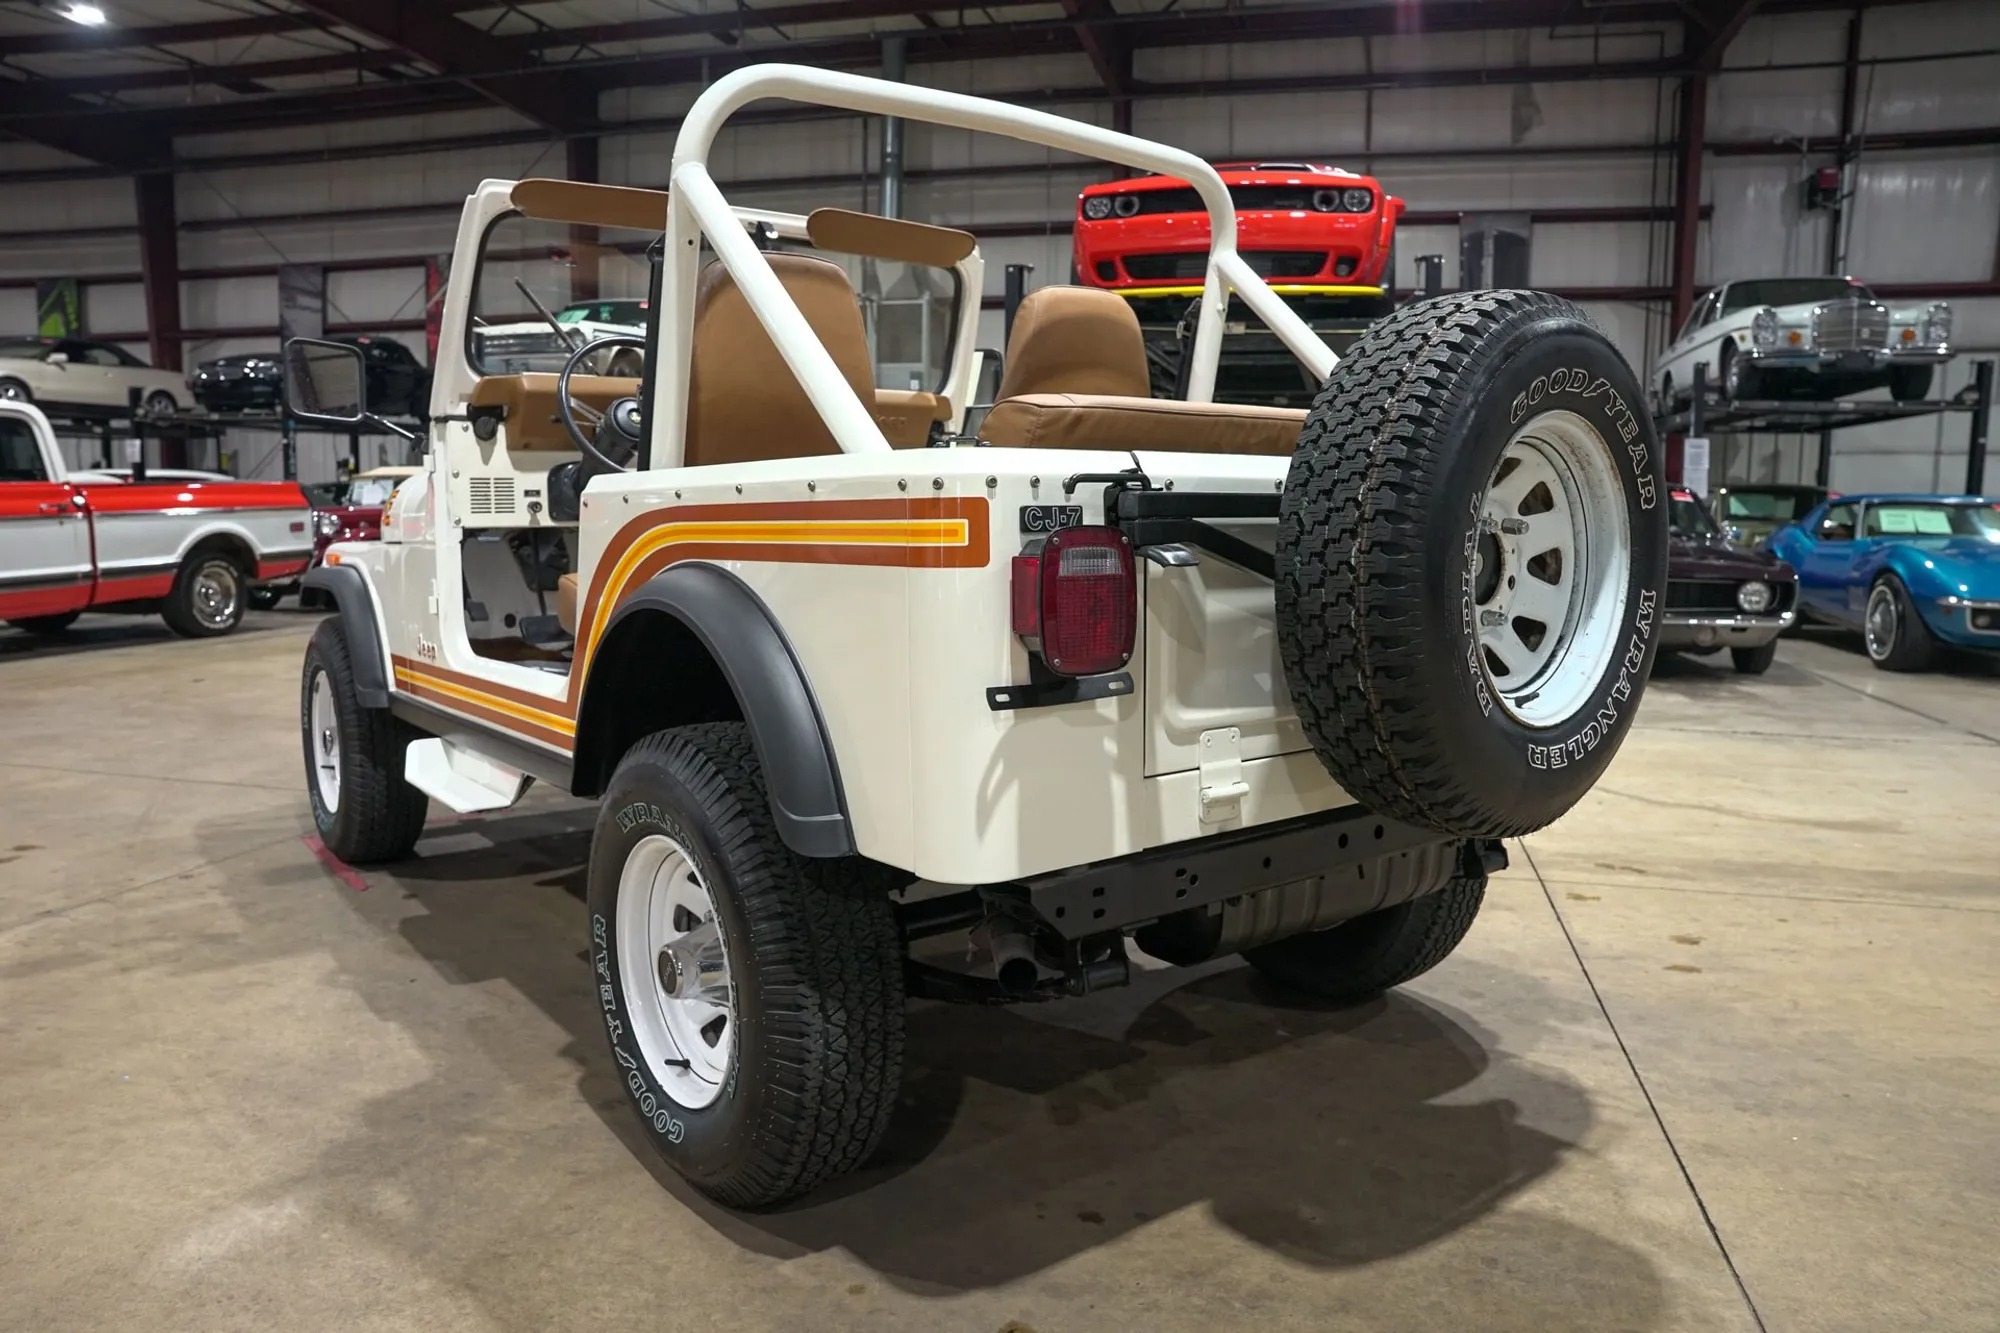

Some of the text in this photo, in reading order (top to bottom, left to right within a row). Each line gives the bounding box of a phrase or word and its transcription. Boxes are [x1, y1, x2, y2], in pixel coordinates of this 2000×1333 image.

[1510, 367, 1657, 510] GOODYEAR
[416, 633, 438, 663] Jeep
[1527, 589, 1657, 770] WRANGLER
[594, 913, 685, 1143] GOODYEAR
